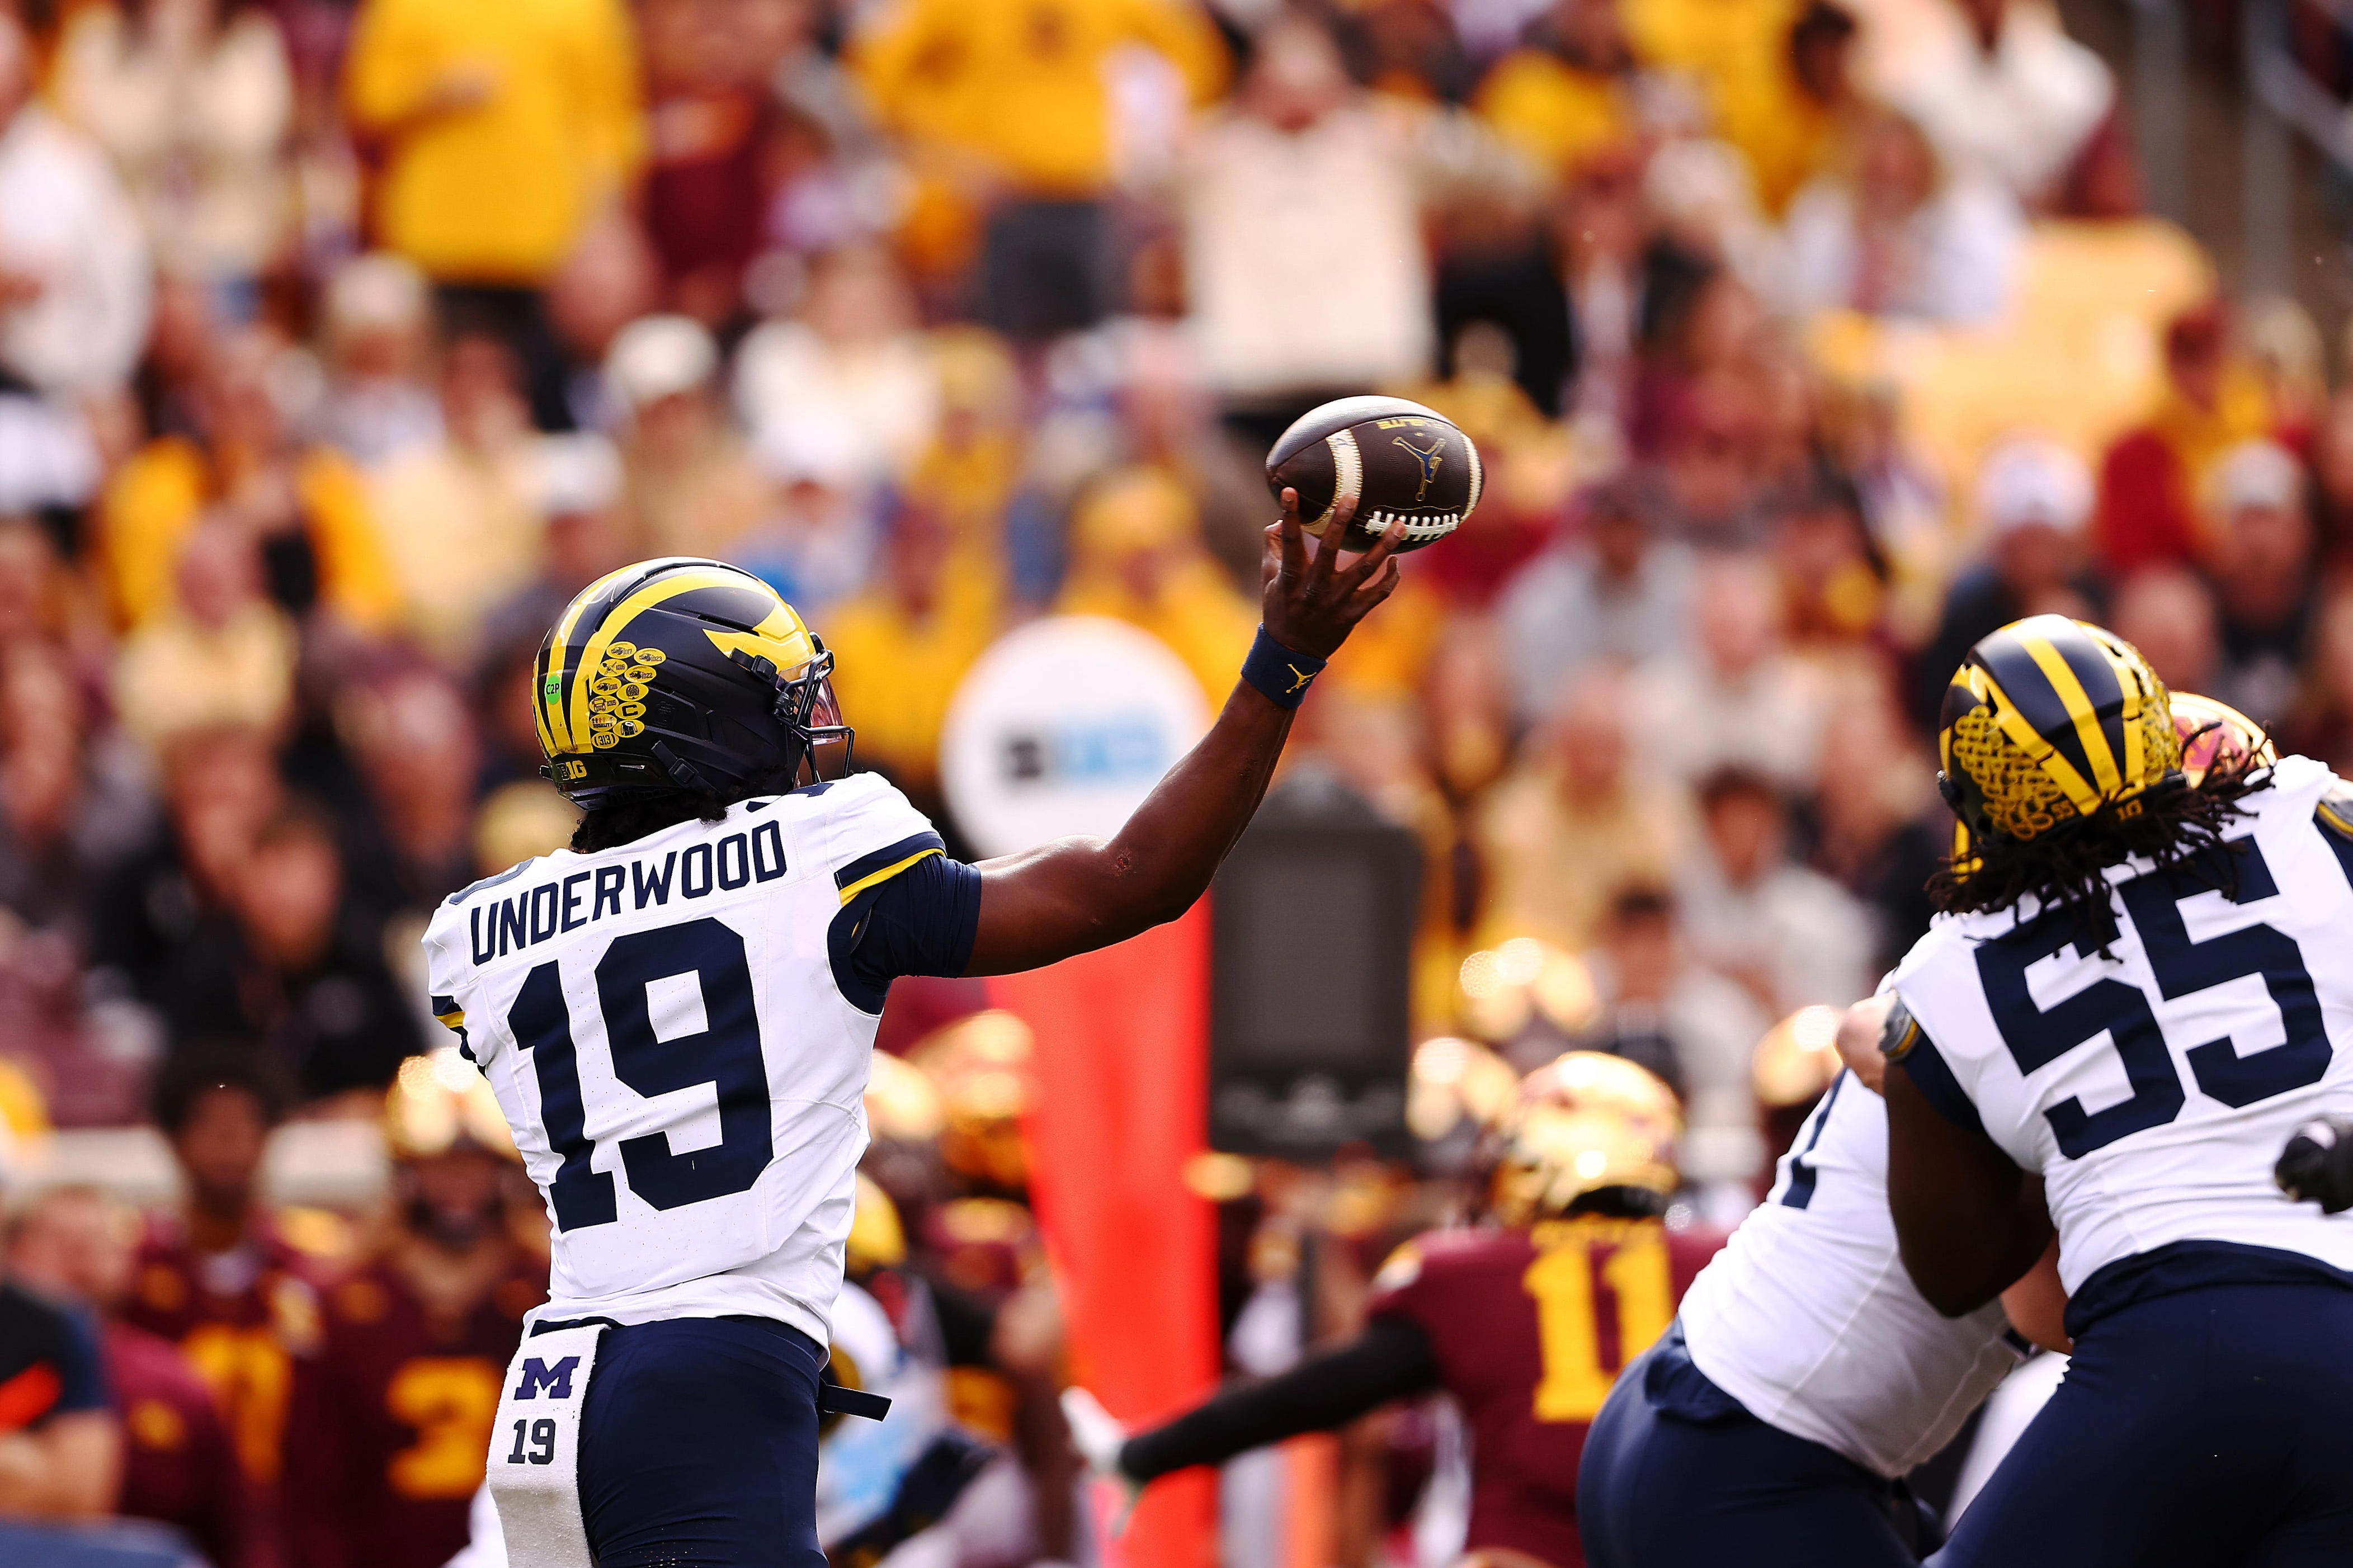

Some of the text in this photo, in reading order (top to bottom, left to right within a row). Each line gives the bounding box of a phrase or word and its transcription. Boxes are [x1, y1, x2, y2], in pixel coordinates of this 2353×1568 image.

[546, 683, 560, 695] C2P
[621, 704, 638, 717] C
[470, 820, 787, 966] UNDERWOOD
[1974, 833, 2333, 1160] 55
[507, 916, 774, 1234] 19
[515, 1356, 580, 1400] M
[1522, 1247, 1673, 1424] 11
[507, 1418, 556, 1465] 19
